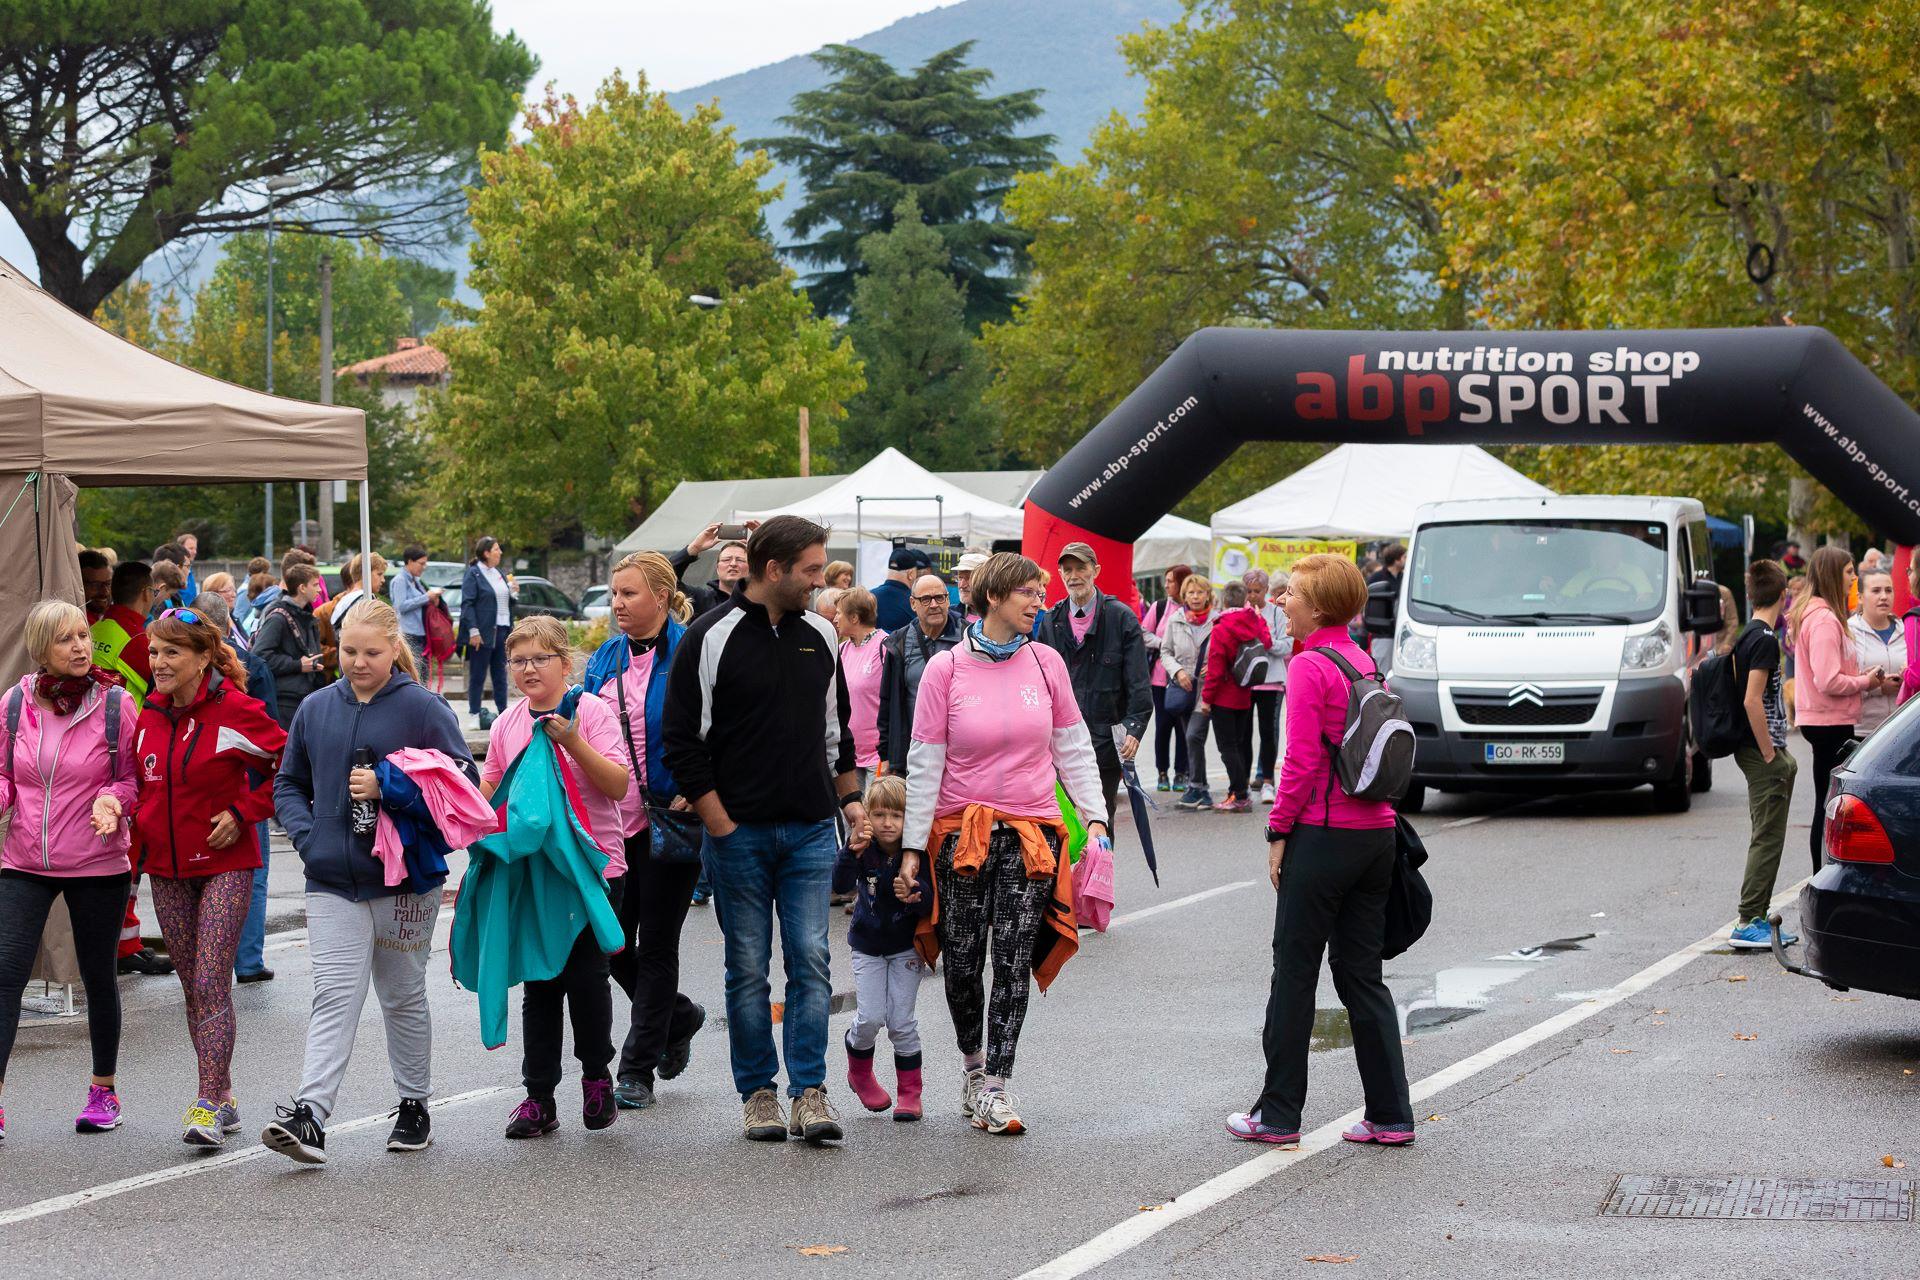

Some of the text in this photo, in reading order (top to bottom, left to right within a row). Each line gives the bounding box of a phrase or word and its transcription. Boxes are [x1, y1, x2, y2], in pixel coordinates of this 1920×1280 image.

[1377, 345, 1701, 380] nutrition shop
[1068, 393, 1199, 509] www.abp-sport.com
[1495, 745, 1562, 759] GO RK-559
[393, 903, 433, 922] rather
[398, 922, 415, 941] be
